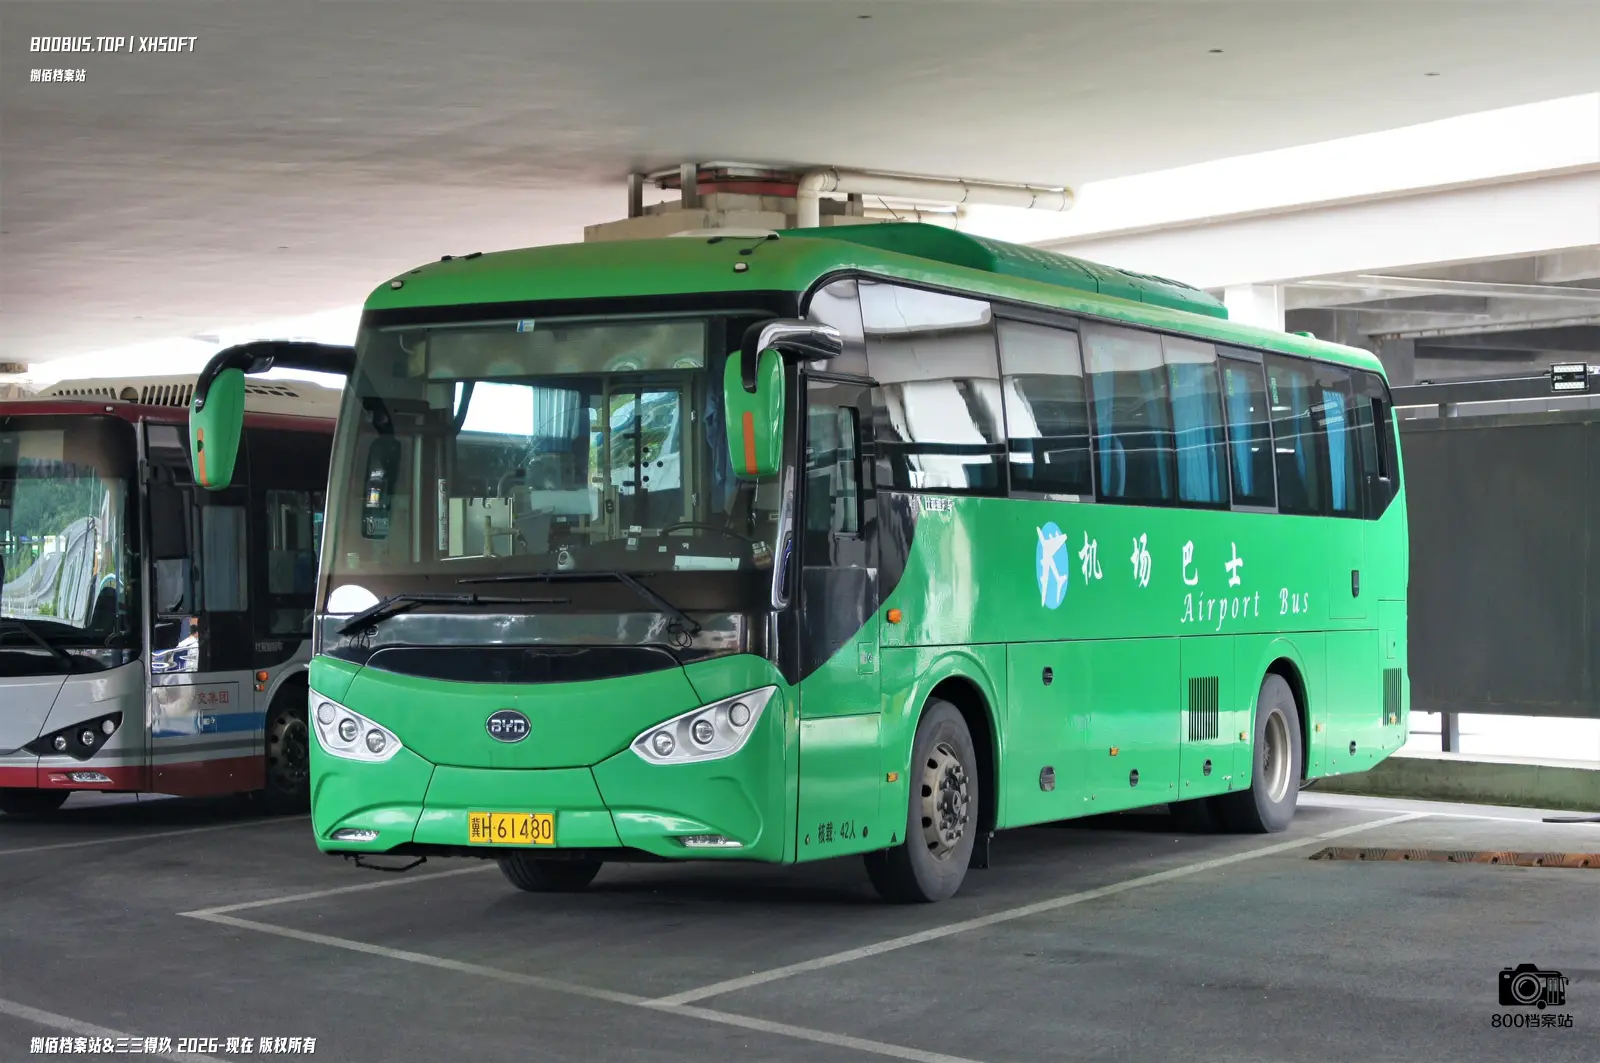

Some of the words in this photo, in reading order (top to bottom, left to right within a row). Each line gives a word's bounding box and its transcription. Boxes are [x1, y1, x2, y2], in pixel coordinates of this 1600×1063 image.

[1078, 531, 1243, 588] 机场巴士
[1181, 590, 1260, 632] Airport
[1279, 587, 1309, 615] Bus
[491, 719, 525, 733] BYD
